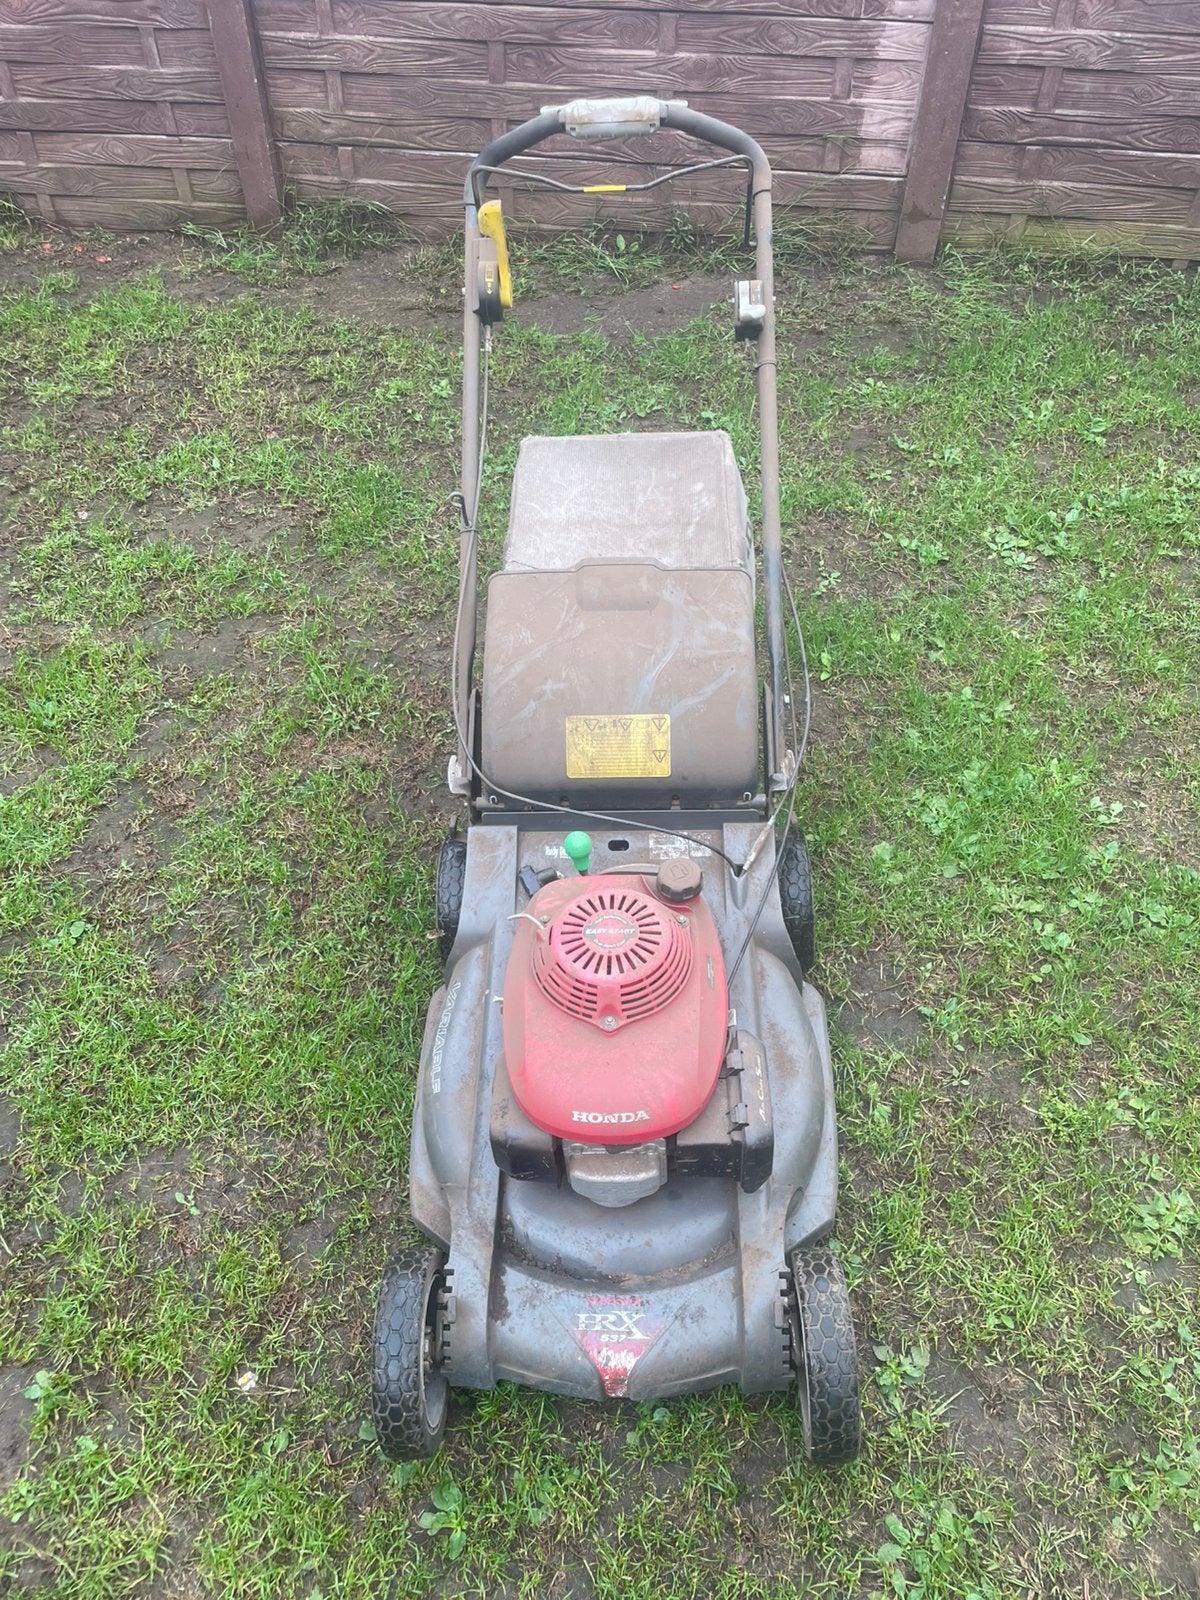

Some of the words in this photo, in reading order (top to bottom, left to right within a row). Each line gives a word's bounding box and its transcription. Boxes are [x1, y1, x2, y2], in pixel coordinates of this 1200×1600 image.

[431, 982, 461, 1094] VARIABLE
[571, 1110, 651, 1124] HONDA
[575, 1310, 652, 1340] HRX
